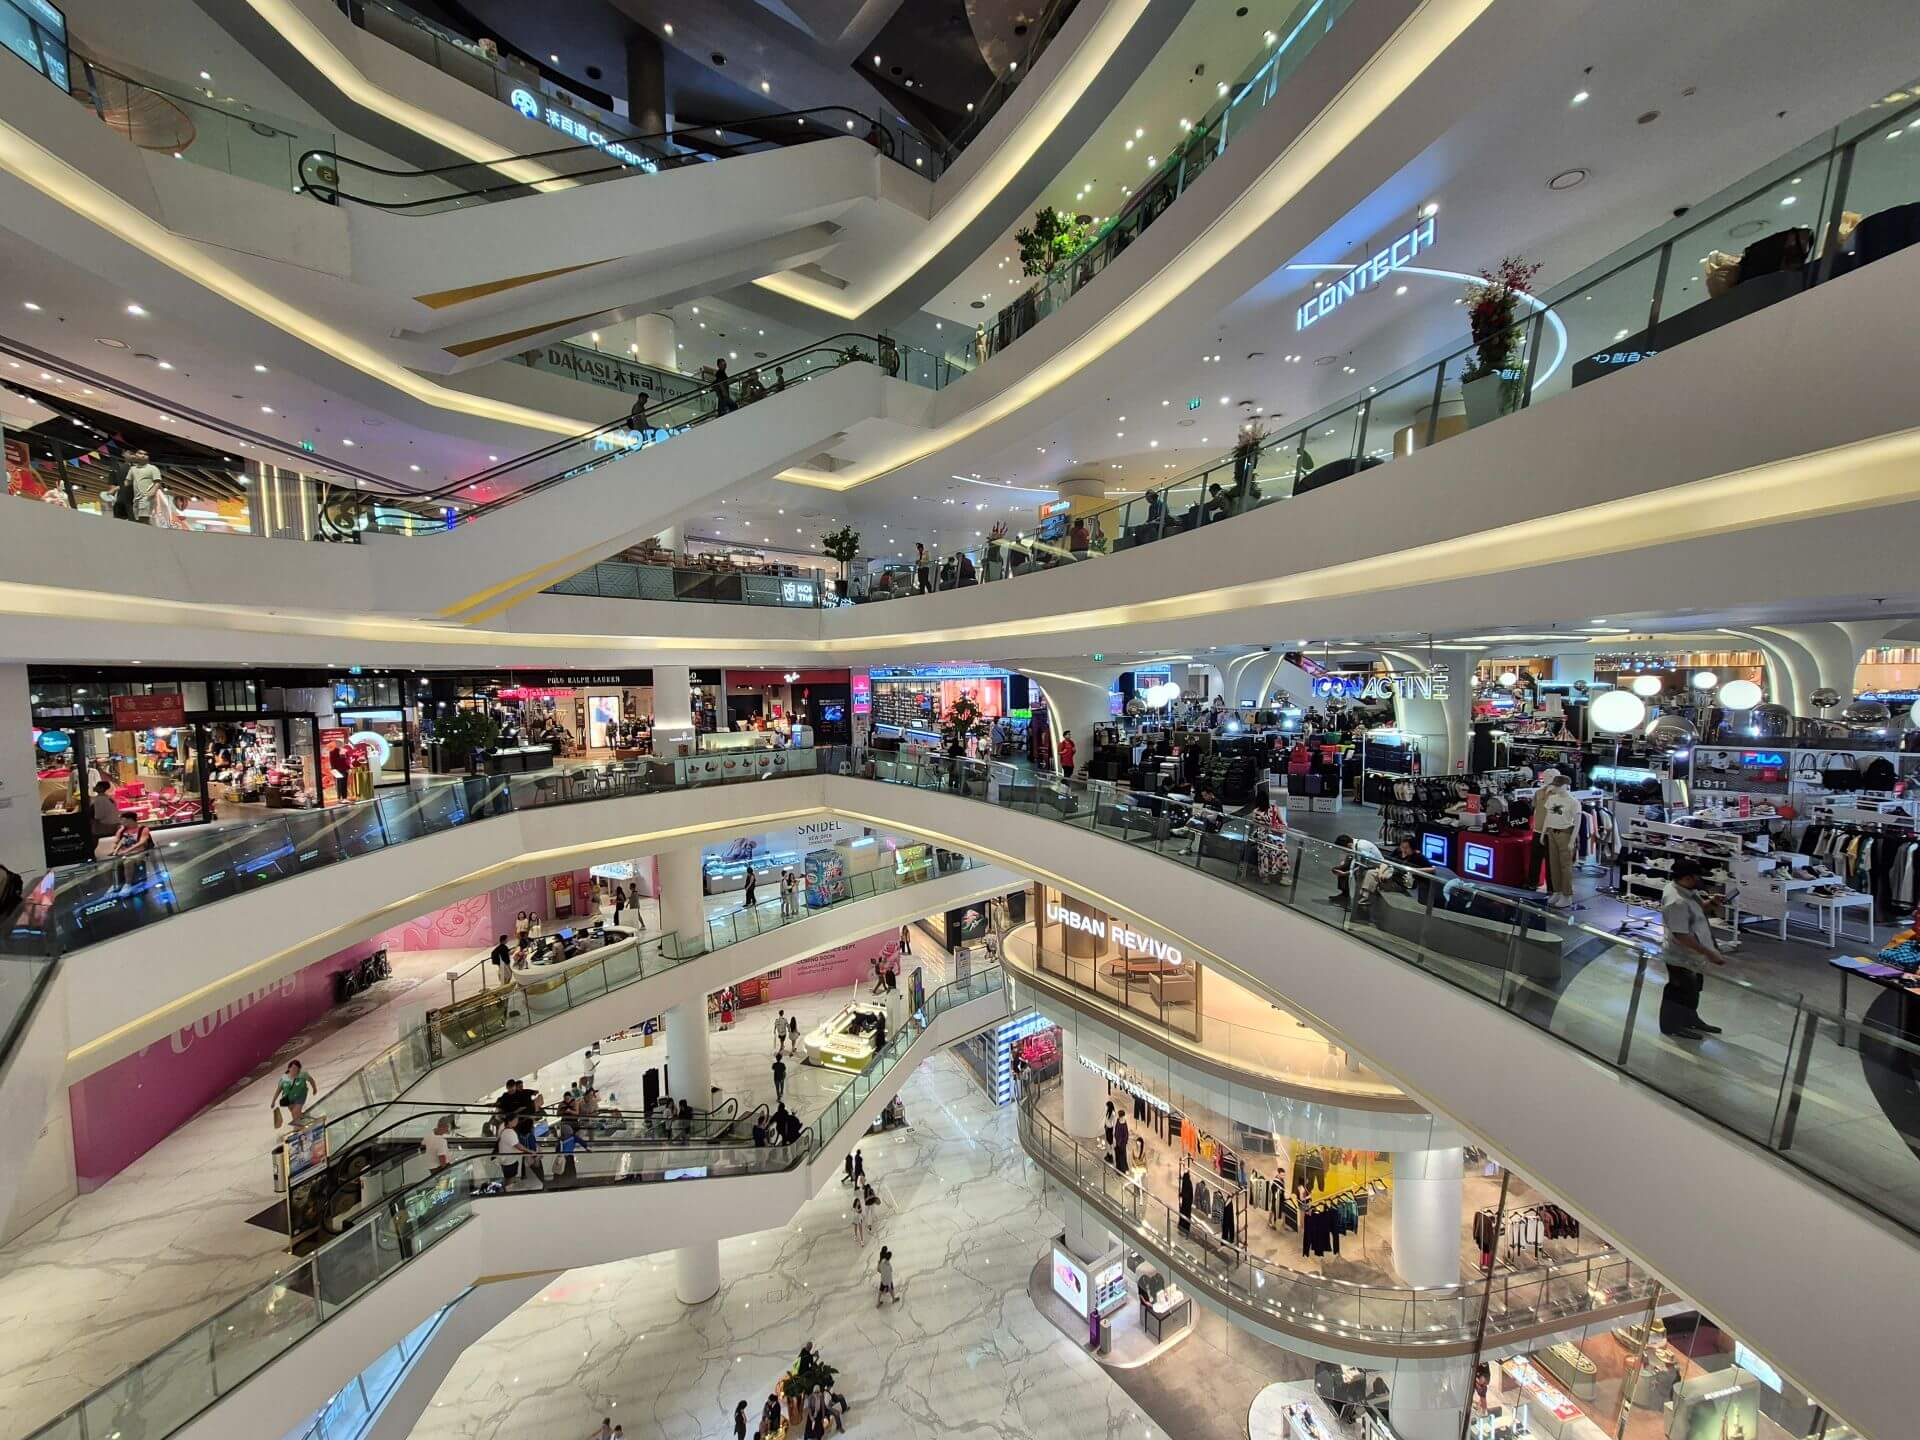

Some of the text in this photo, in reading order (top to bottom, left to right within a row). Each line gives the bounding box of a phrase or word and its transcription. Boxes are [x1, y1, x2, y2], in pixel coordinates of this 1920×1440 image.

[1296, 217, 1436, 331] ICONTECH
[549, 348, 610, 380] DAKASI
[797, 584, 812, 593] KOI
[1743, 752, 1783, 764] FILA
[1695, 779, 1727, 788] 1911
[798, 820, 842, 835] SNIDEL
[1510, 817, 1538, 827] FILA
[1047, 904, 1183, 966] URBAN REVIVO
